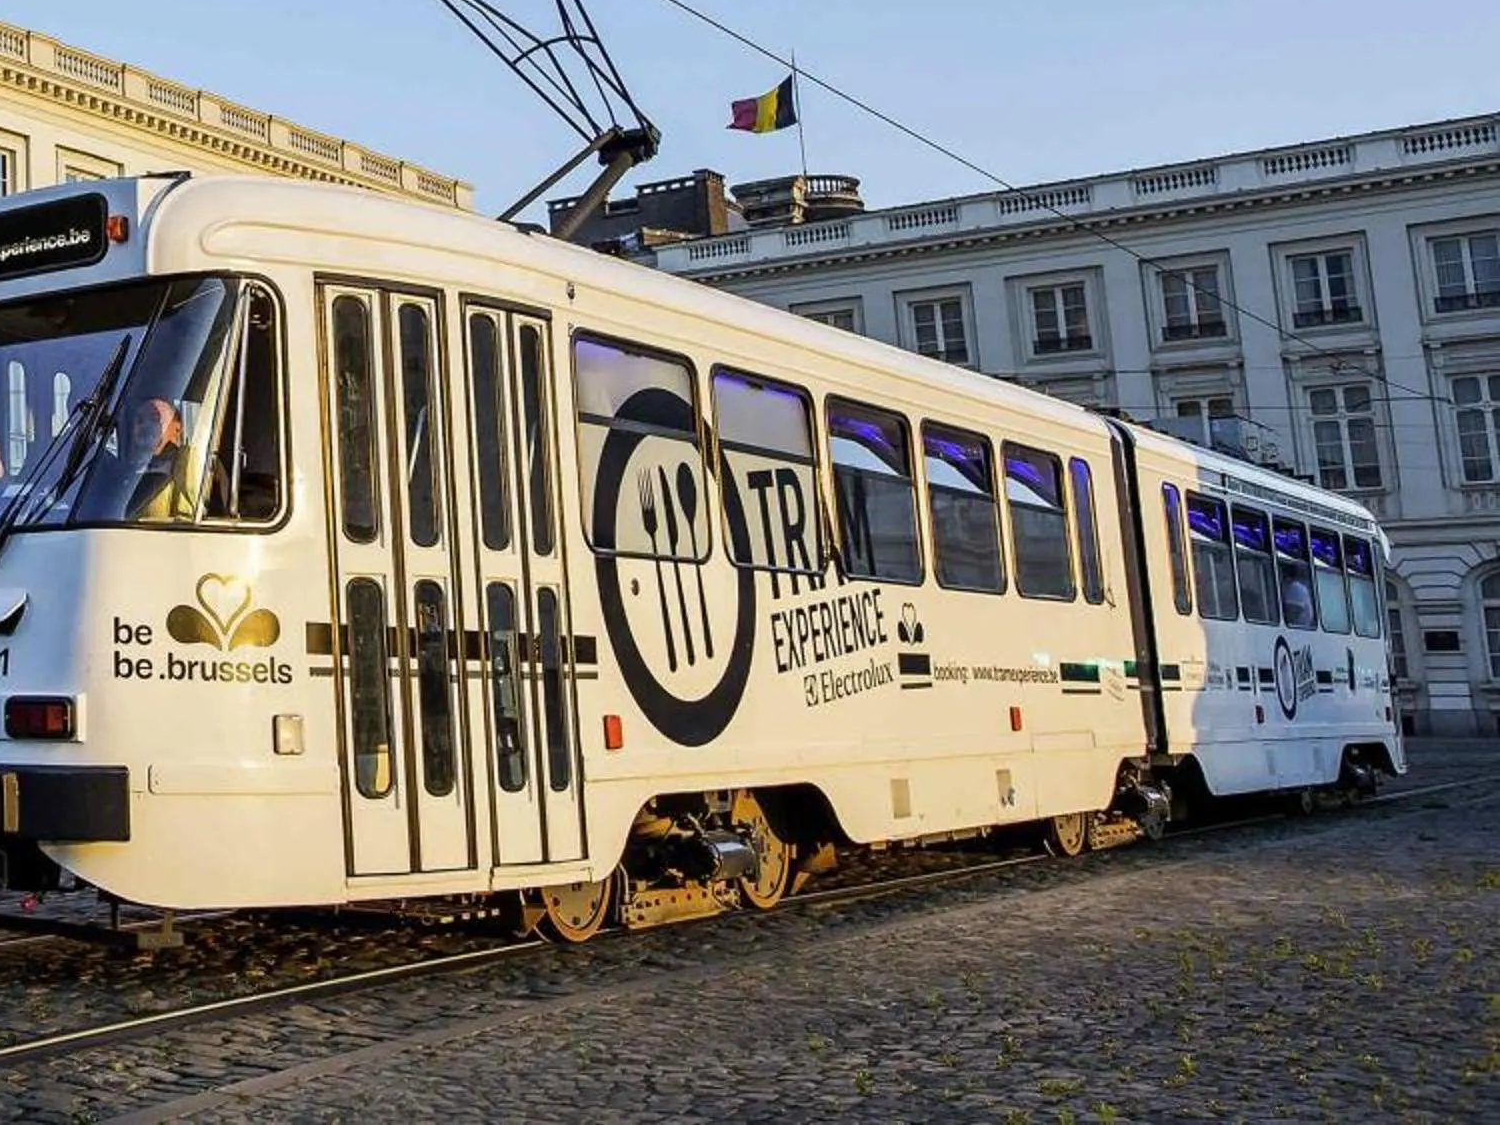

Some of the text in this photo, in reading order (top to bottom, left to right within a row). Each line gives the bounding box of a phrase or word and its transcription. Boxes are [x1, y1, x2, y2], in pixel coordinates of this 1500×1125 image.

[113, 616, 153, 644] be
[771, 589, 888, 673] EXPERIENCE
[113, 650, 153, 679] be
[821, 658, 894, 703] Electrolux
